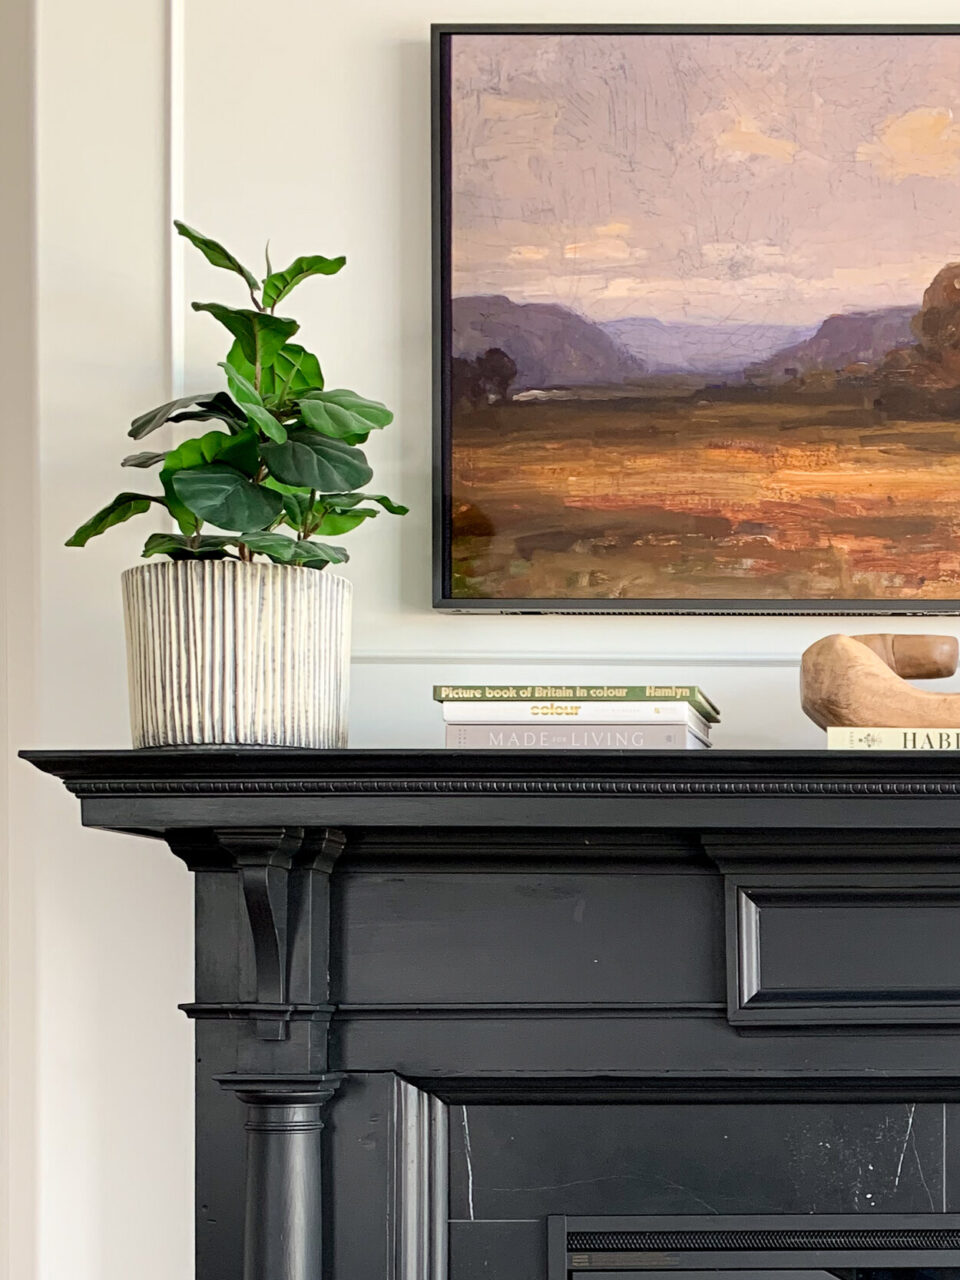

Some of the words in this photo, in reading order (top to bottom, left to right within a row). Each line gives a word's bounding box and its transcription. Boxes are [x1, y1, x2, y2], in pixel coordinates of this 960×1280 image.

[441, 687, 482, 698] Picture
[485, 687, 517, 697] book
[519, 686, 532, 697] of
[535, 686, 573, 697] Britain
[576, 686, 587, 697] in
[590, 686, 628, 697] colour
[646, 686, 690, 699] Hamlyn
[530, 703, 581, 715] colour
[488, 732, 549, 746] MADE
[571, 732, 645, 746] LIVING
